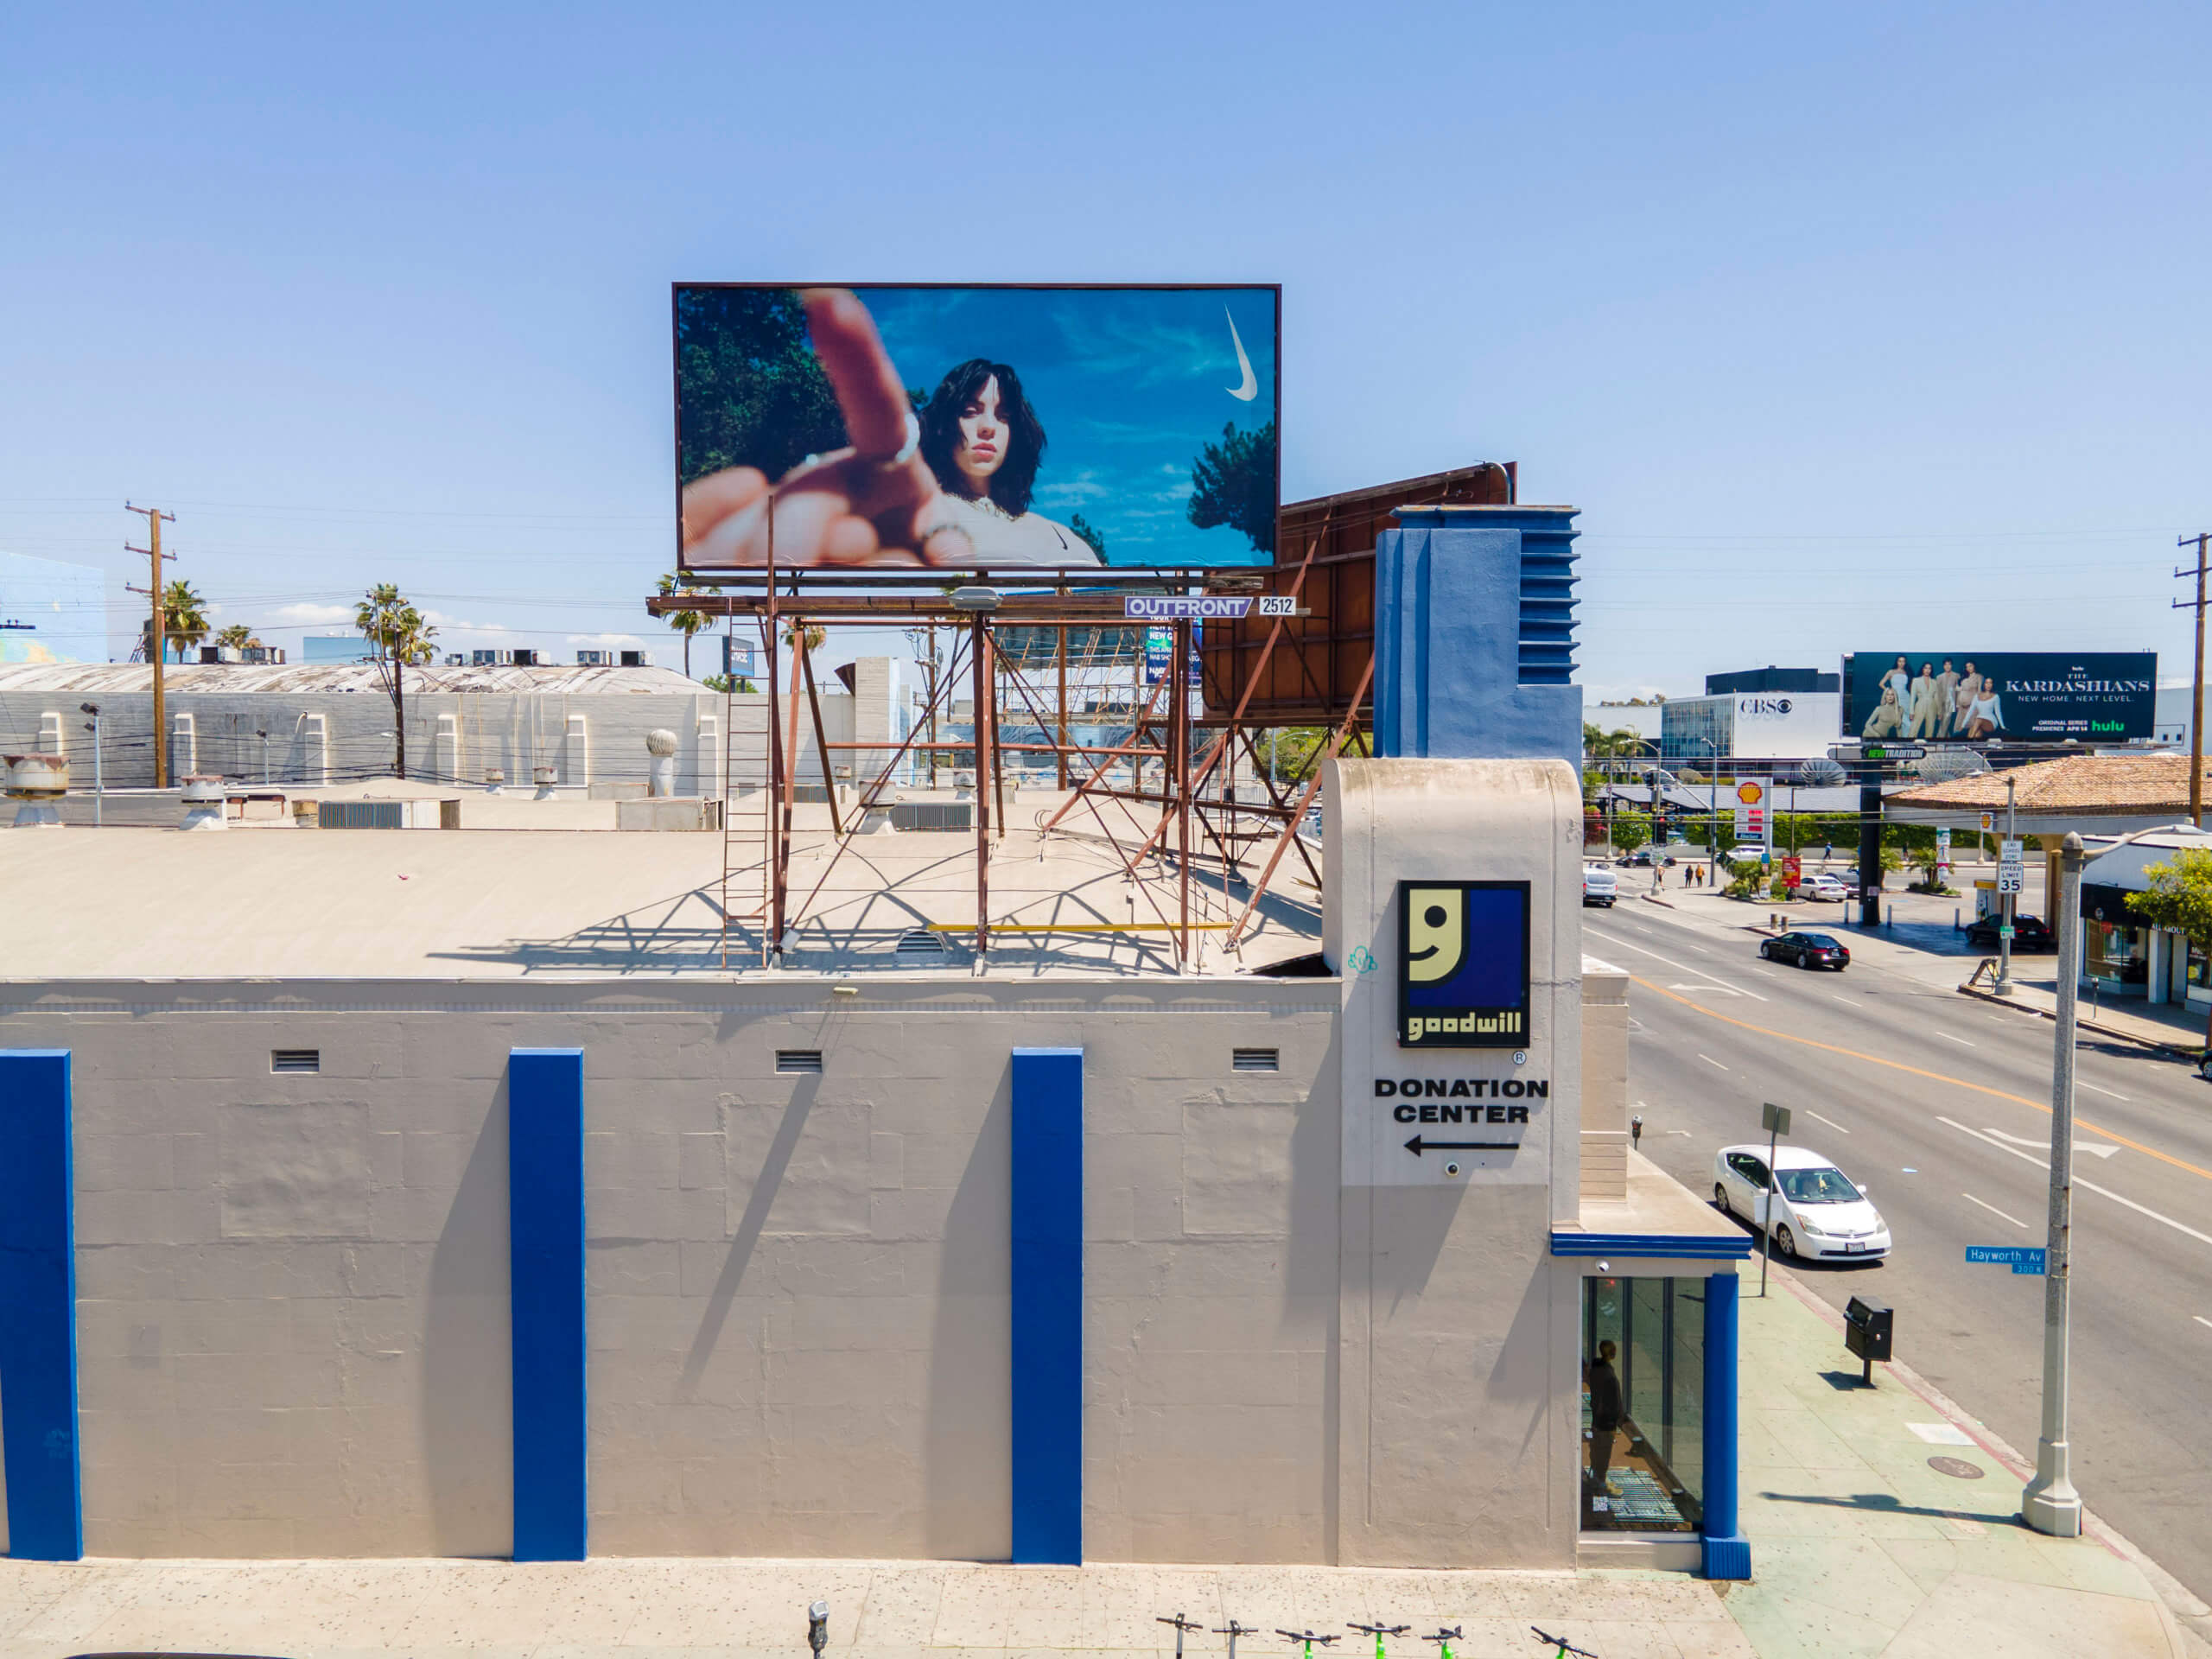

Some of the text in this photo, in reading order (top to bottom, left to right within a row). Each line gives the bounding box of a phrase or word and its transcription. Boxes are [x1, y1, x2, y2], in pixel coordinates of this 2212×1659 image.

[1129, 599, 1245, 616] OUTFRONT
[1263, 598, 1293, 613] 2512
[2005, 680, 2150, 692] KARDASHIANS
[1741, 699, 1777, 714] CBS
[2092, 720, 2125, 731] hulu
[2000, 880, 2020, 891] 35
[1408, 1012, 1521, 1041] goodwill
[1375, 1079, 1548, 1097] DONATION
[1394, 1104, 1529, 1123] CENTER
[1971, 1249, 2041, 1263] Hayworth Av
